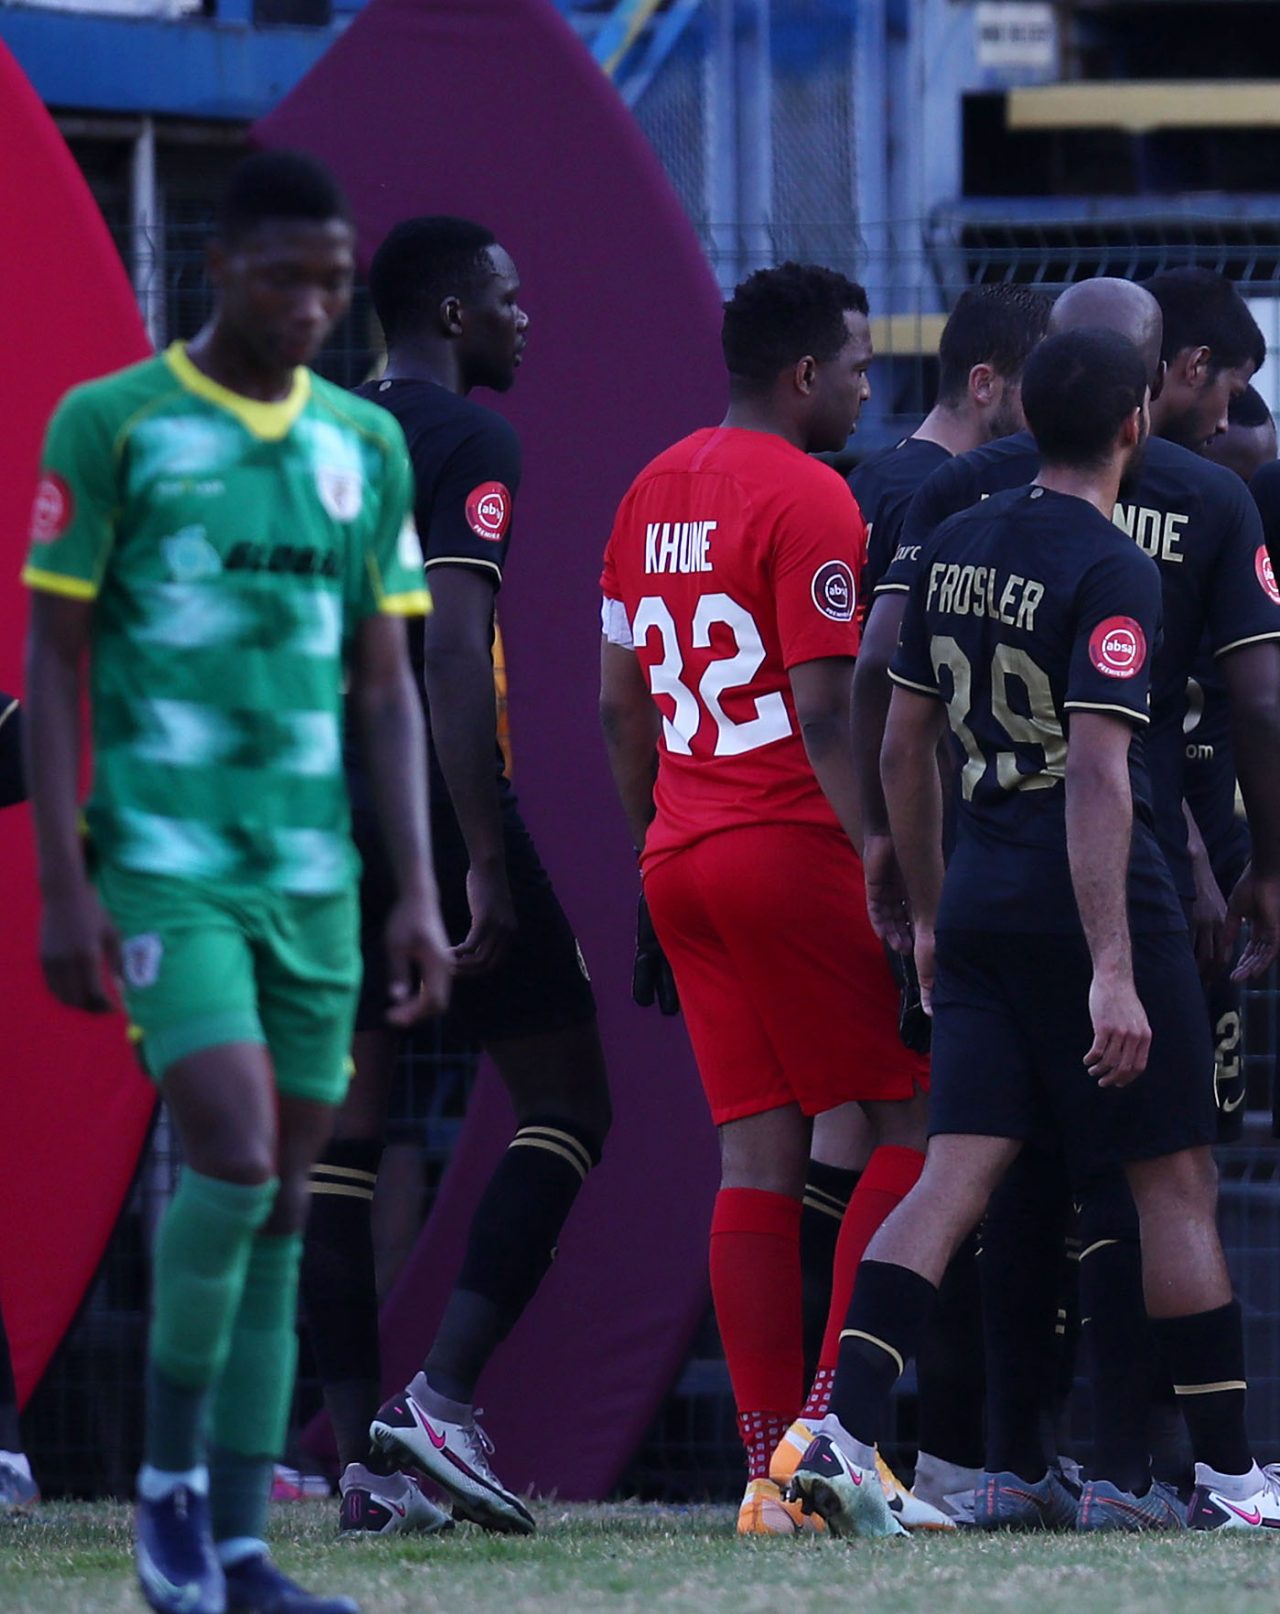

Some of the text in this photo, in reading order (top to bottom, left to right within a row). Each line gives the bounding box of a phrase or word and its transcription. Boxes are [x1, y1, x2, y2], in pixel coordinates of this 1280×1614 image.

[645, 521, 717, 574] KHUNE
[1112, 503, 1189, 562] NDE
[926, 562, 1045, 631] FROSLER
[633, 593, 793, 757] 32
[1185, 744, 1214, 760] om
